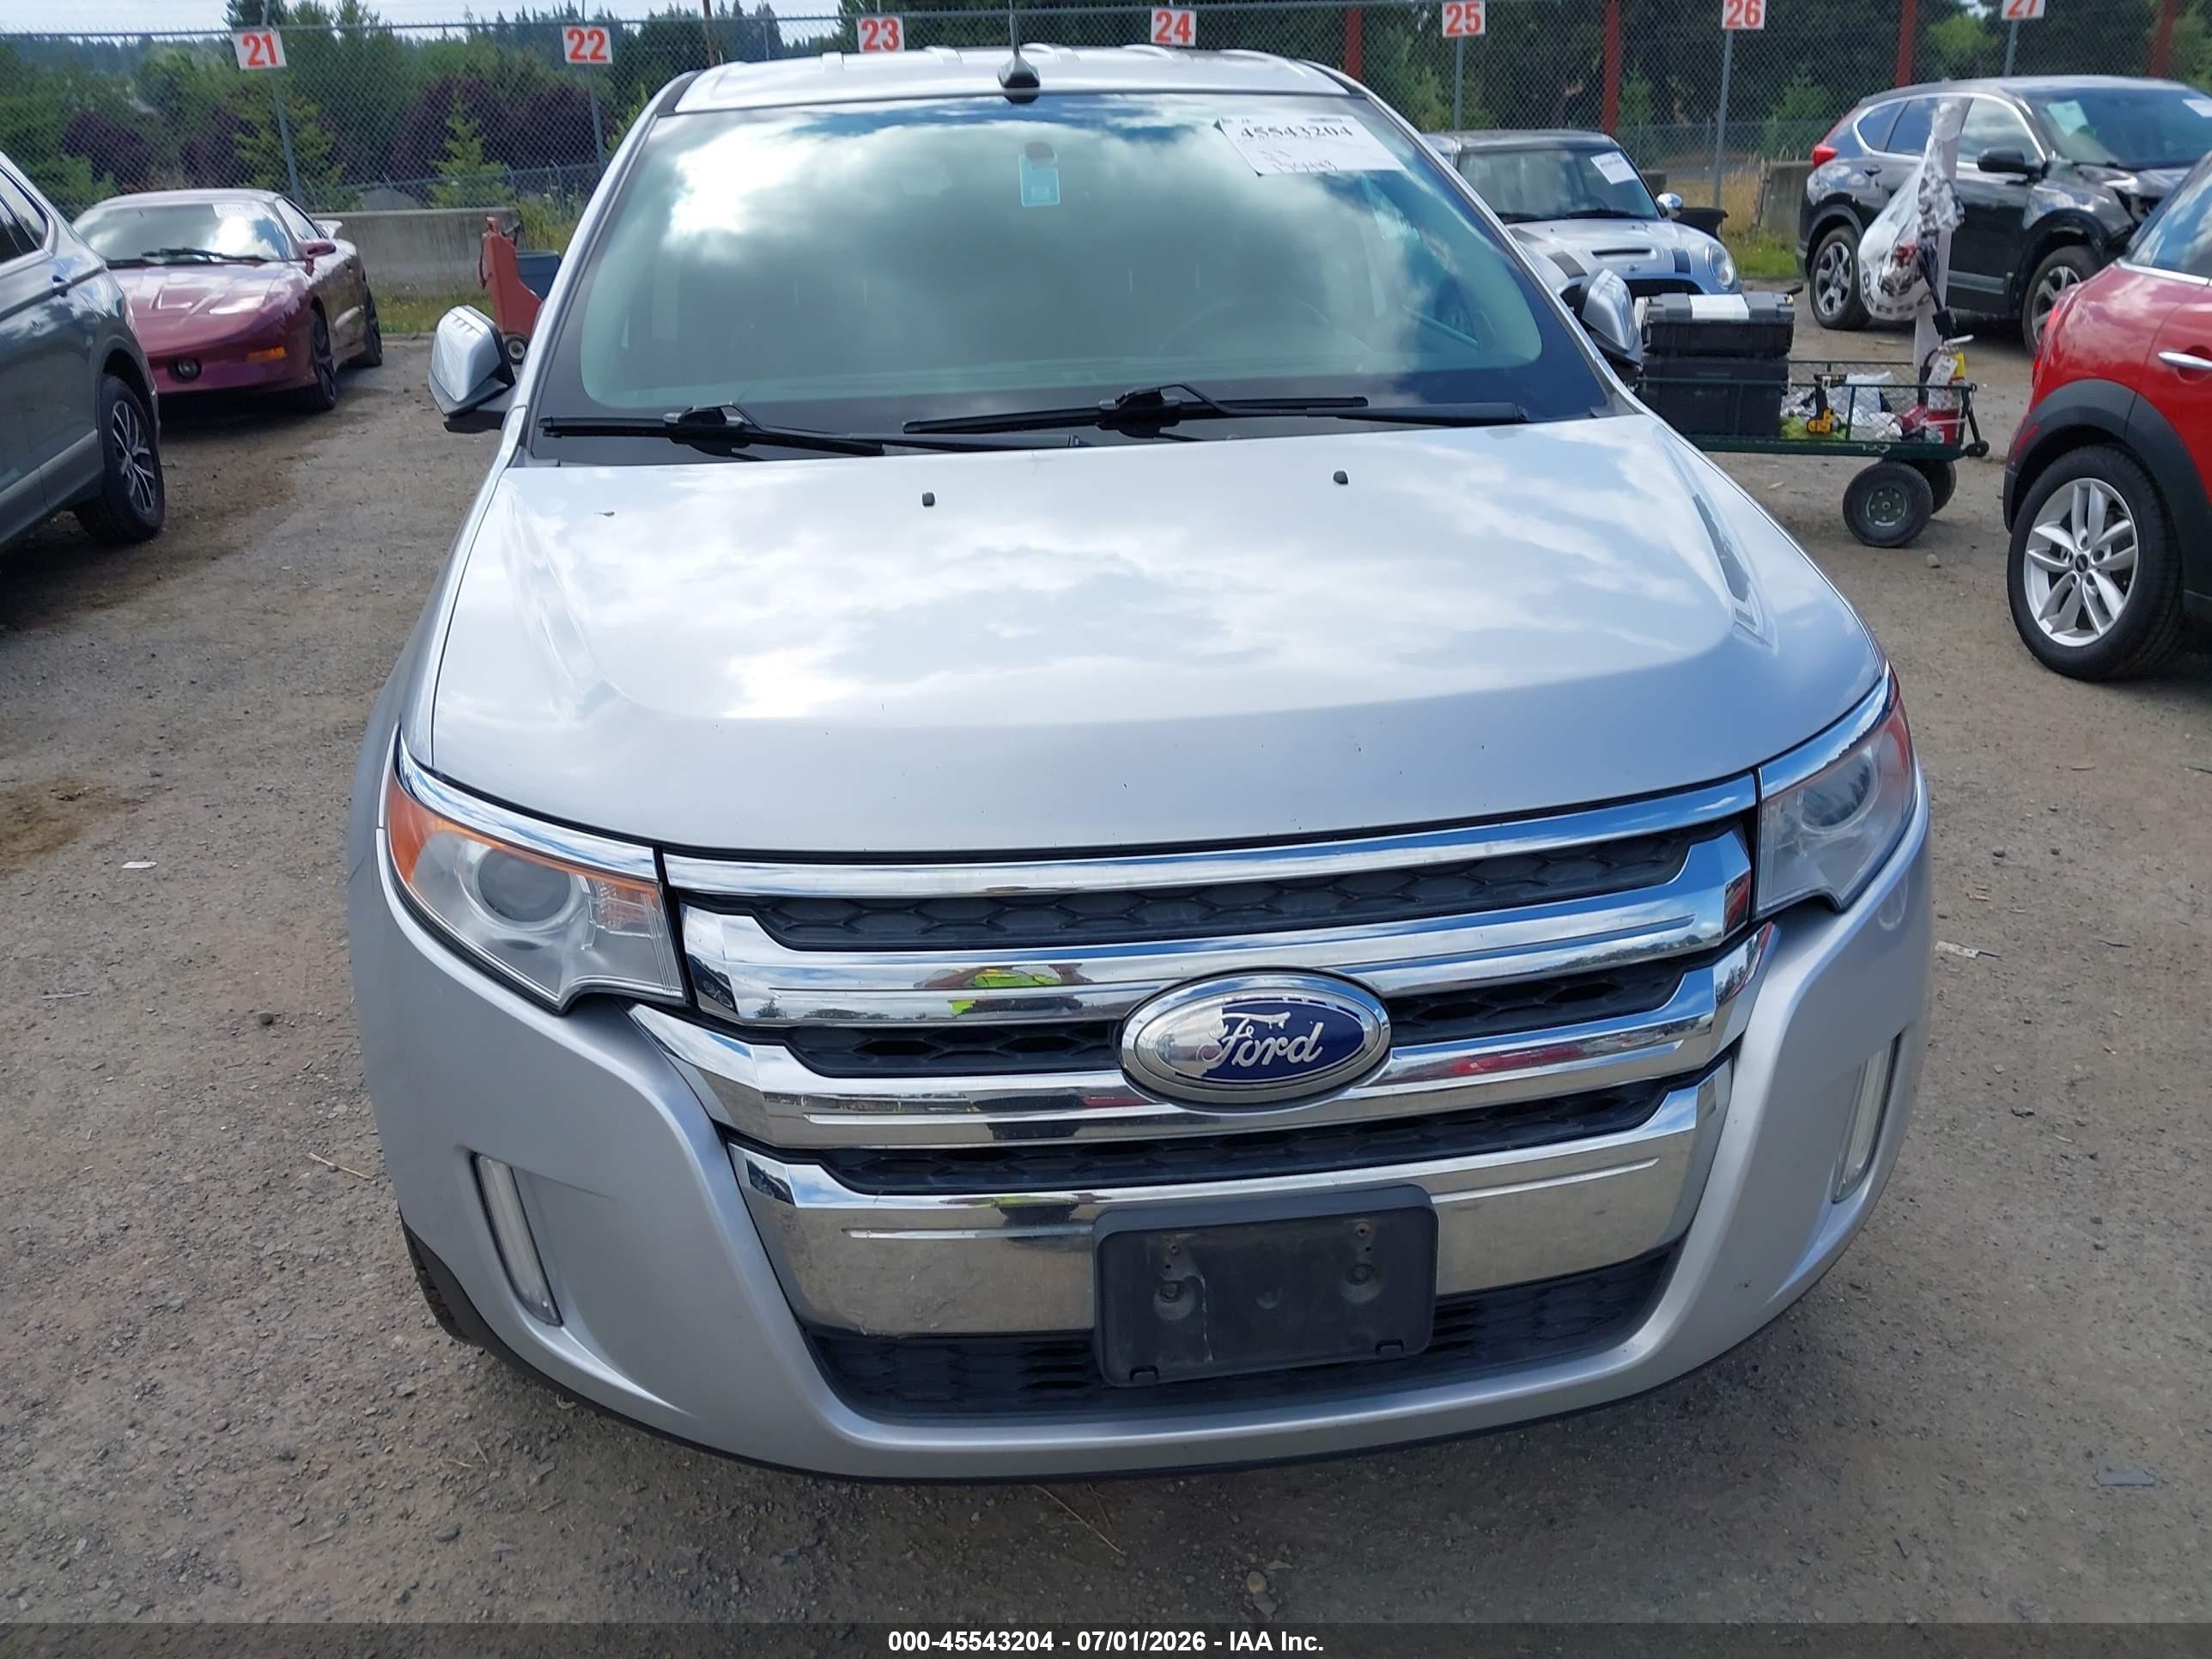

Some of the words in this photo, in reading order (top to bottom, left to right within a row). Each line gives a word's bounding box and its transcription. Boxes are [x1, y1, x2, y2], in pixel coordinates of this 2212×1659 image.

[1155, 11, 1192, 41] 24
[1446, 2, 1481, 34] 25
[1726, 0, 1760, 27] 26
[243, 33, 276, 65] 21
[567, 27, 607, 60] 22
[861, 19, 899, 51] 23
[1197, 1011, 1324, 1066] Ford
